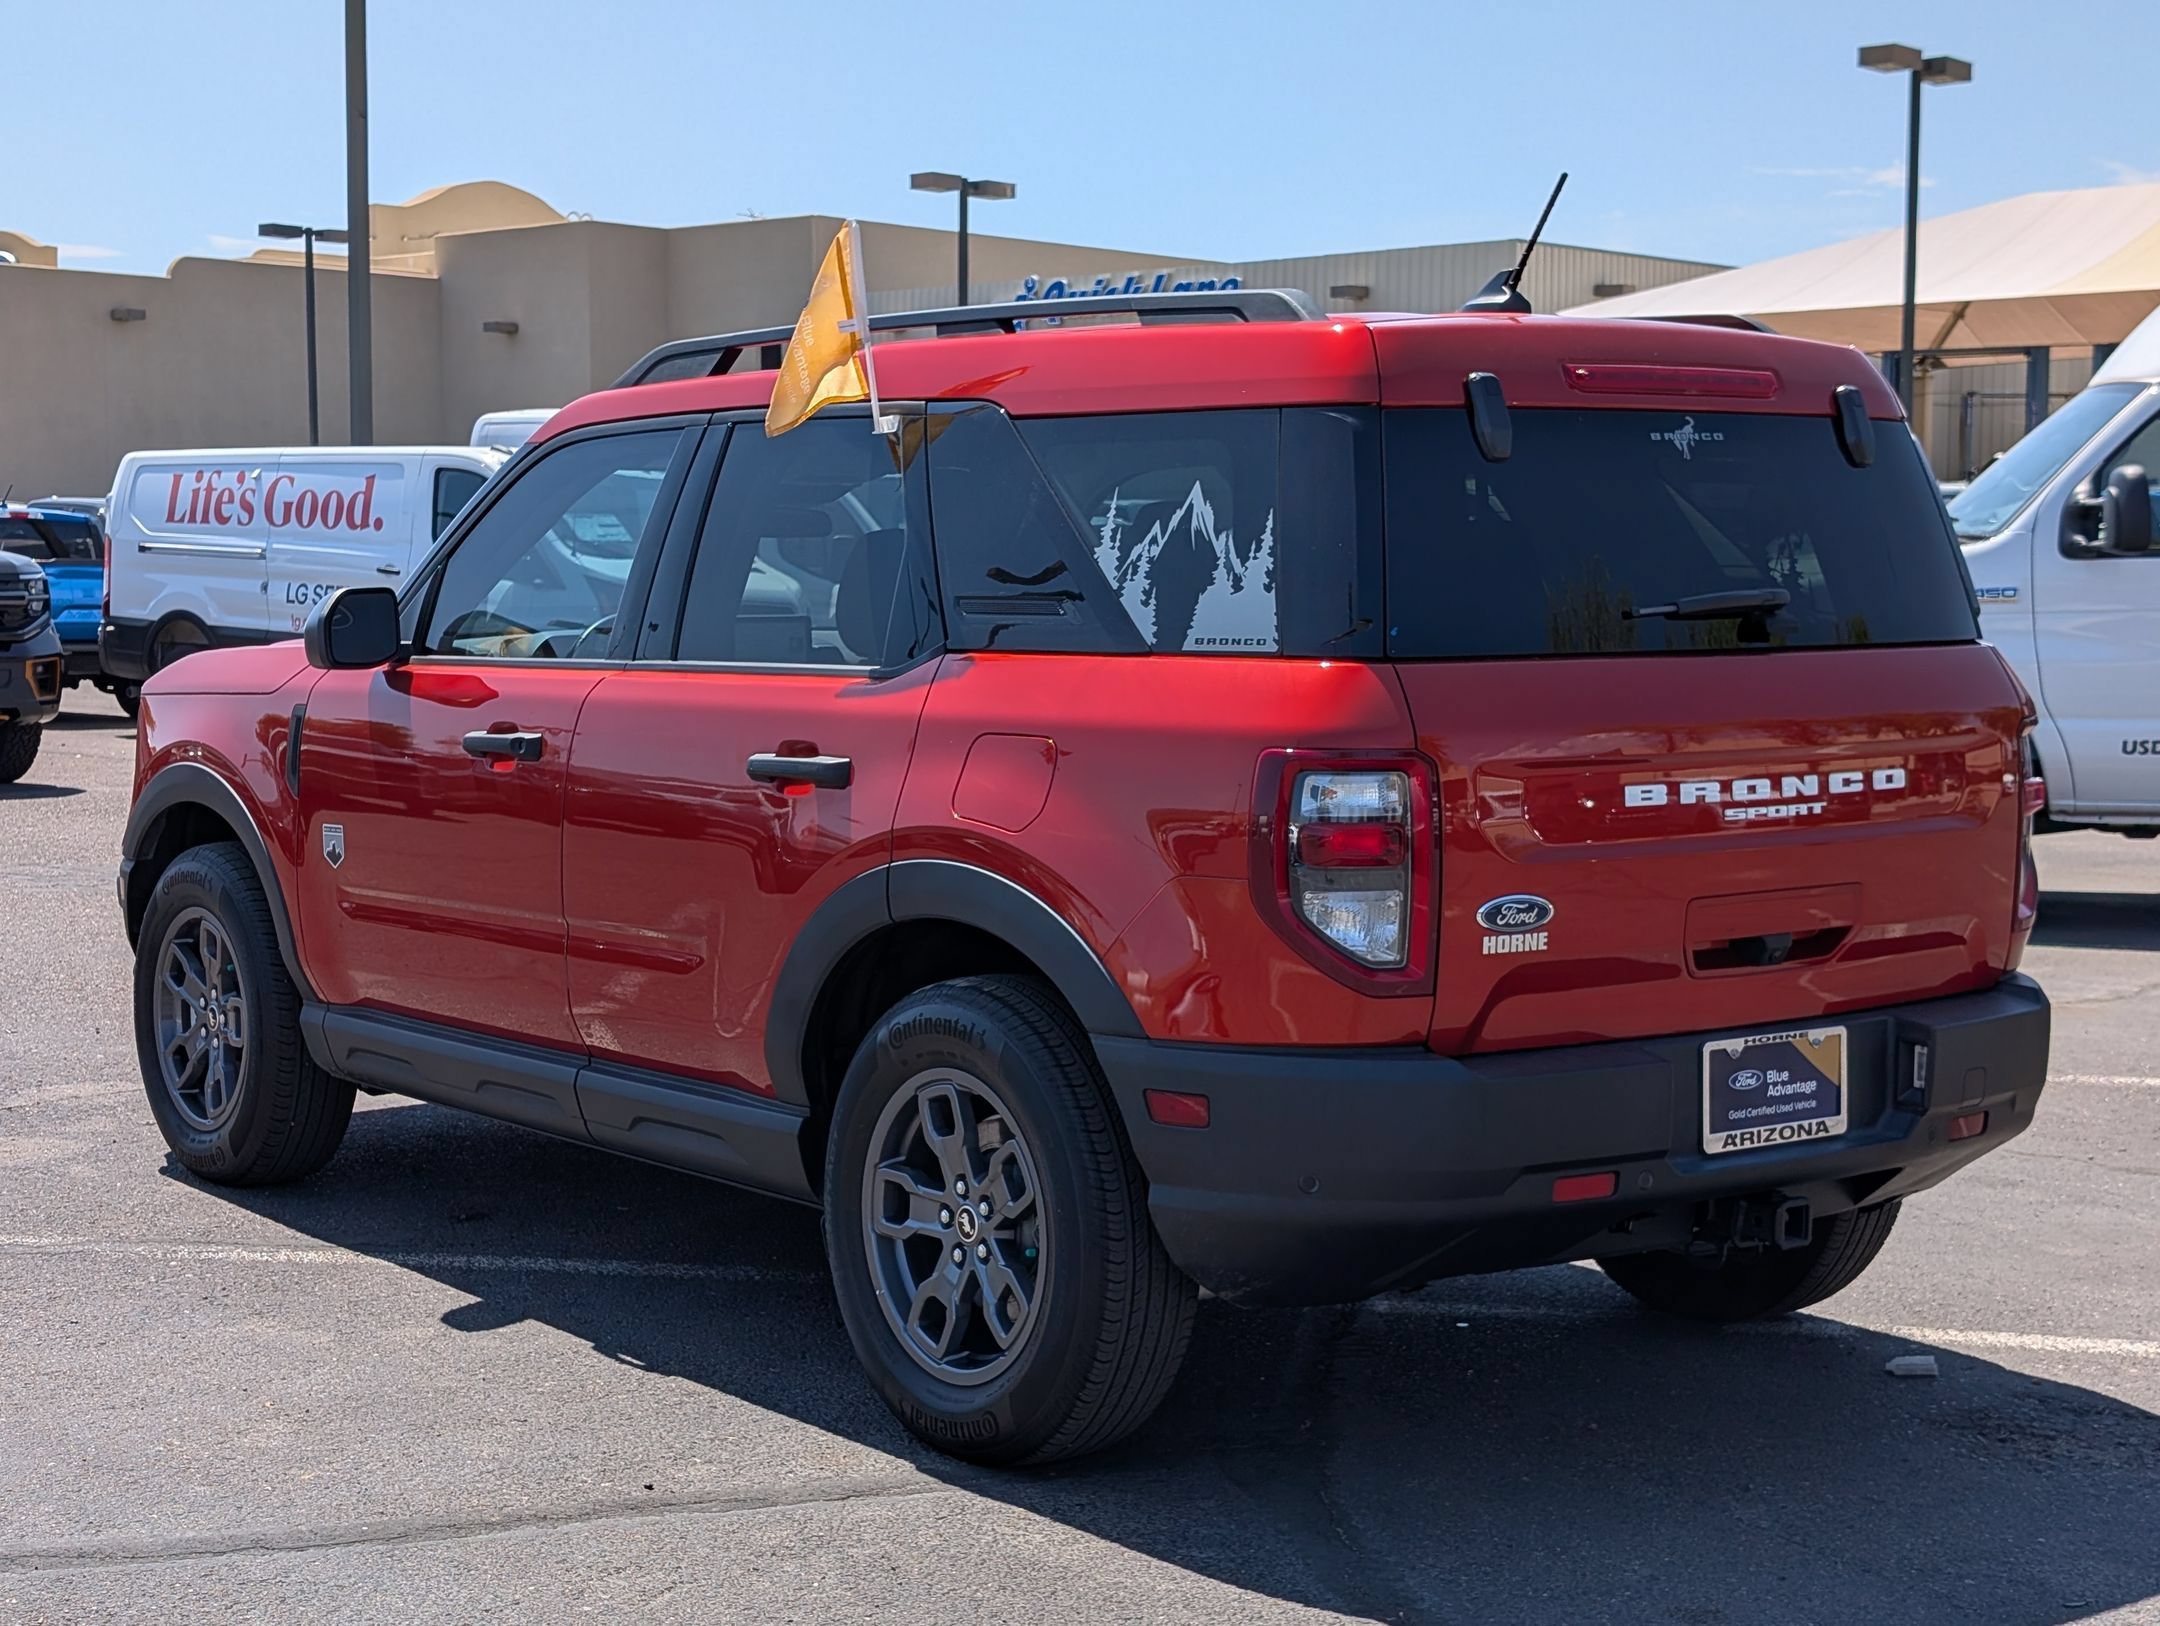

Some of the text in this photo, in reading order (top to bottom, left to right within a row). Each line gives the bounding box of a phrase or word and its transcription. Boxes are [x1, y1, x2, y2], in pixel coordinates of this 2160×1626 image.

[801, 314, 816, 348] Blue
[1650, 432, 1724, 441] BRONCO
[165, 469, 384, 532] Life's Good.
[286, 582, 309, 605] LG
[1194, 637, 1267, 646] BRONCO
[1624, 768, 1906, 808] BRONCO
[1723, 801, 1828, 821] SPORT
[1497, 903, 1538, 925] Ford
[1482, 932, 1548, 955] HORNE
[888, 1012, 977, 1050] Continental
[1735, 1072, 1757, 1087] Ford
[1766, 1069, 1790, 1083] Blue
[1766, 1079, 1817, 1097] Advantage
[1728, 1099, 1817, 1120] Gold Certified Used Vehicle
[1721, 1120, 1831, 1149] ARIZONA
